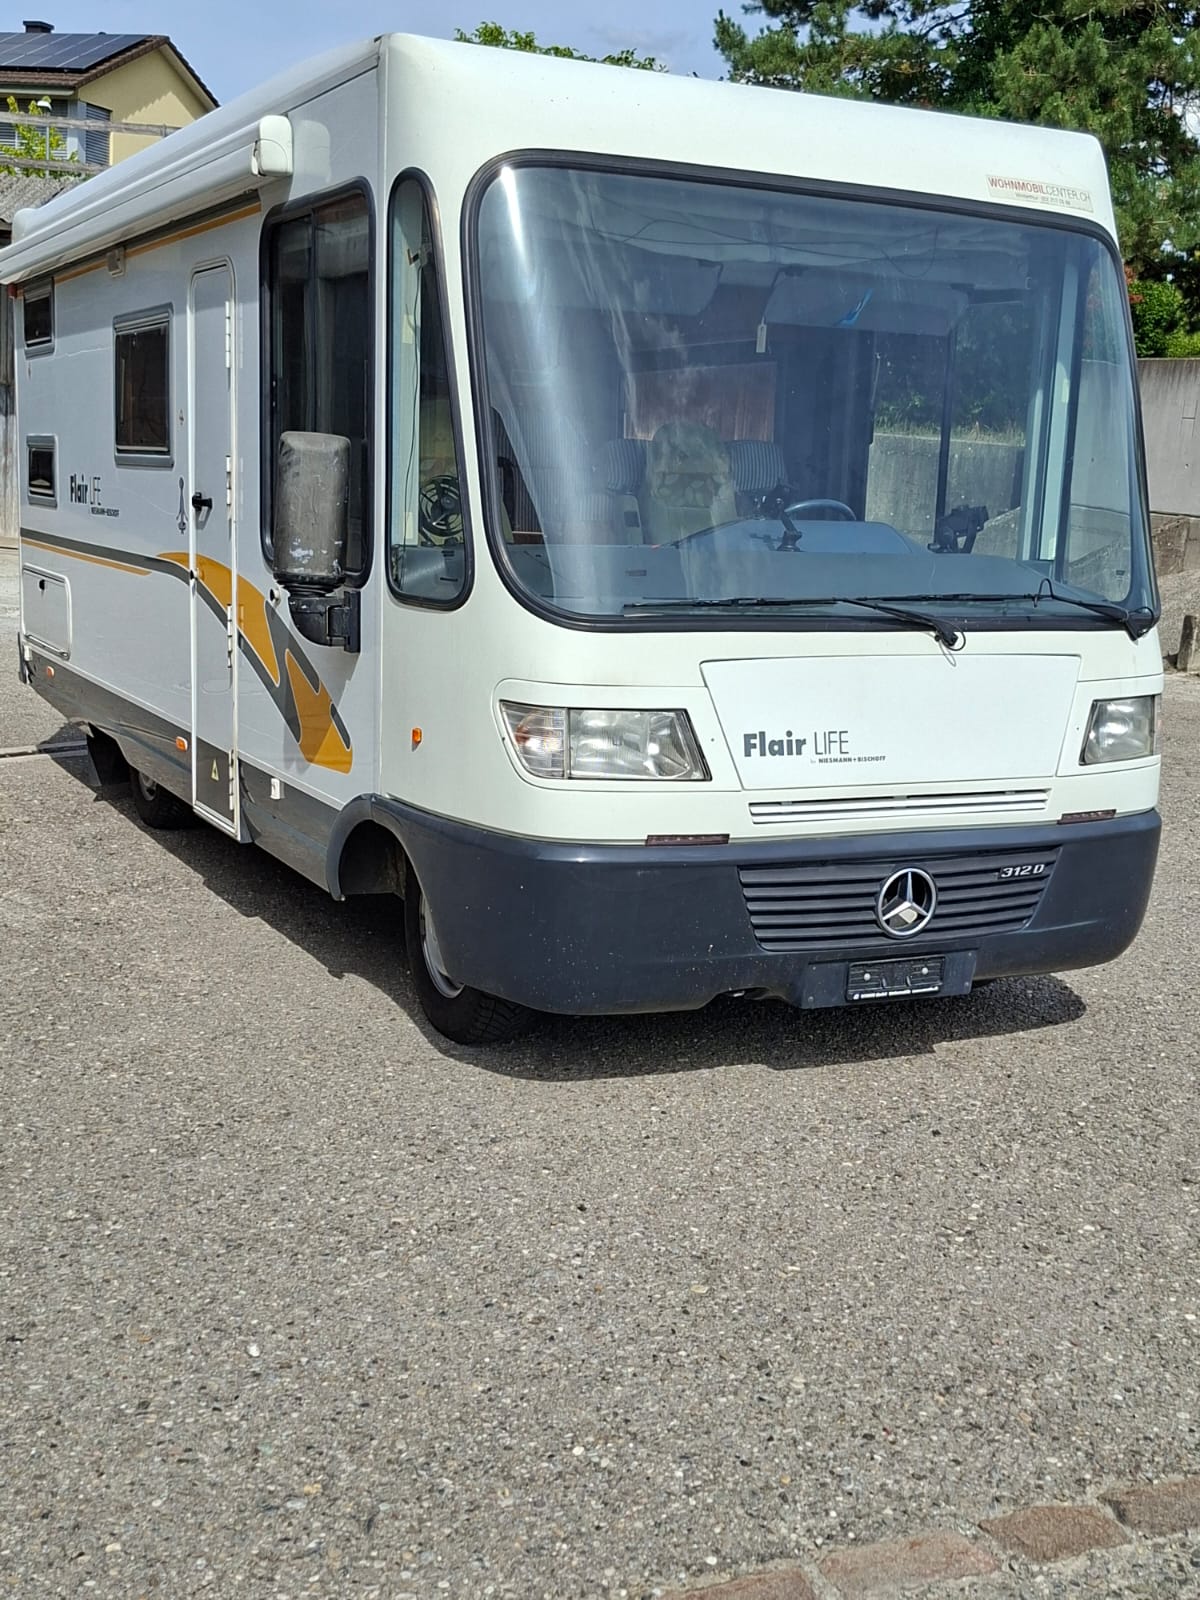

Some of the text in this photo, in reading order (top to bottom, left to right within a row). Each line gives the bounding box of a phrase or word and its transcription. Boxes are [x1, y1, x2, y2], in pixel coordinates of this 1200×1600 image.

[70, 473, 88, 505] Flair
[743, 730, 849, 757] Flair LIFE
